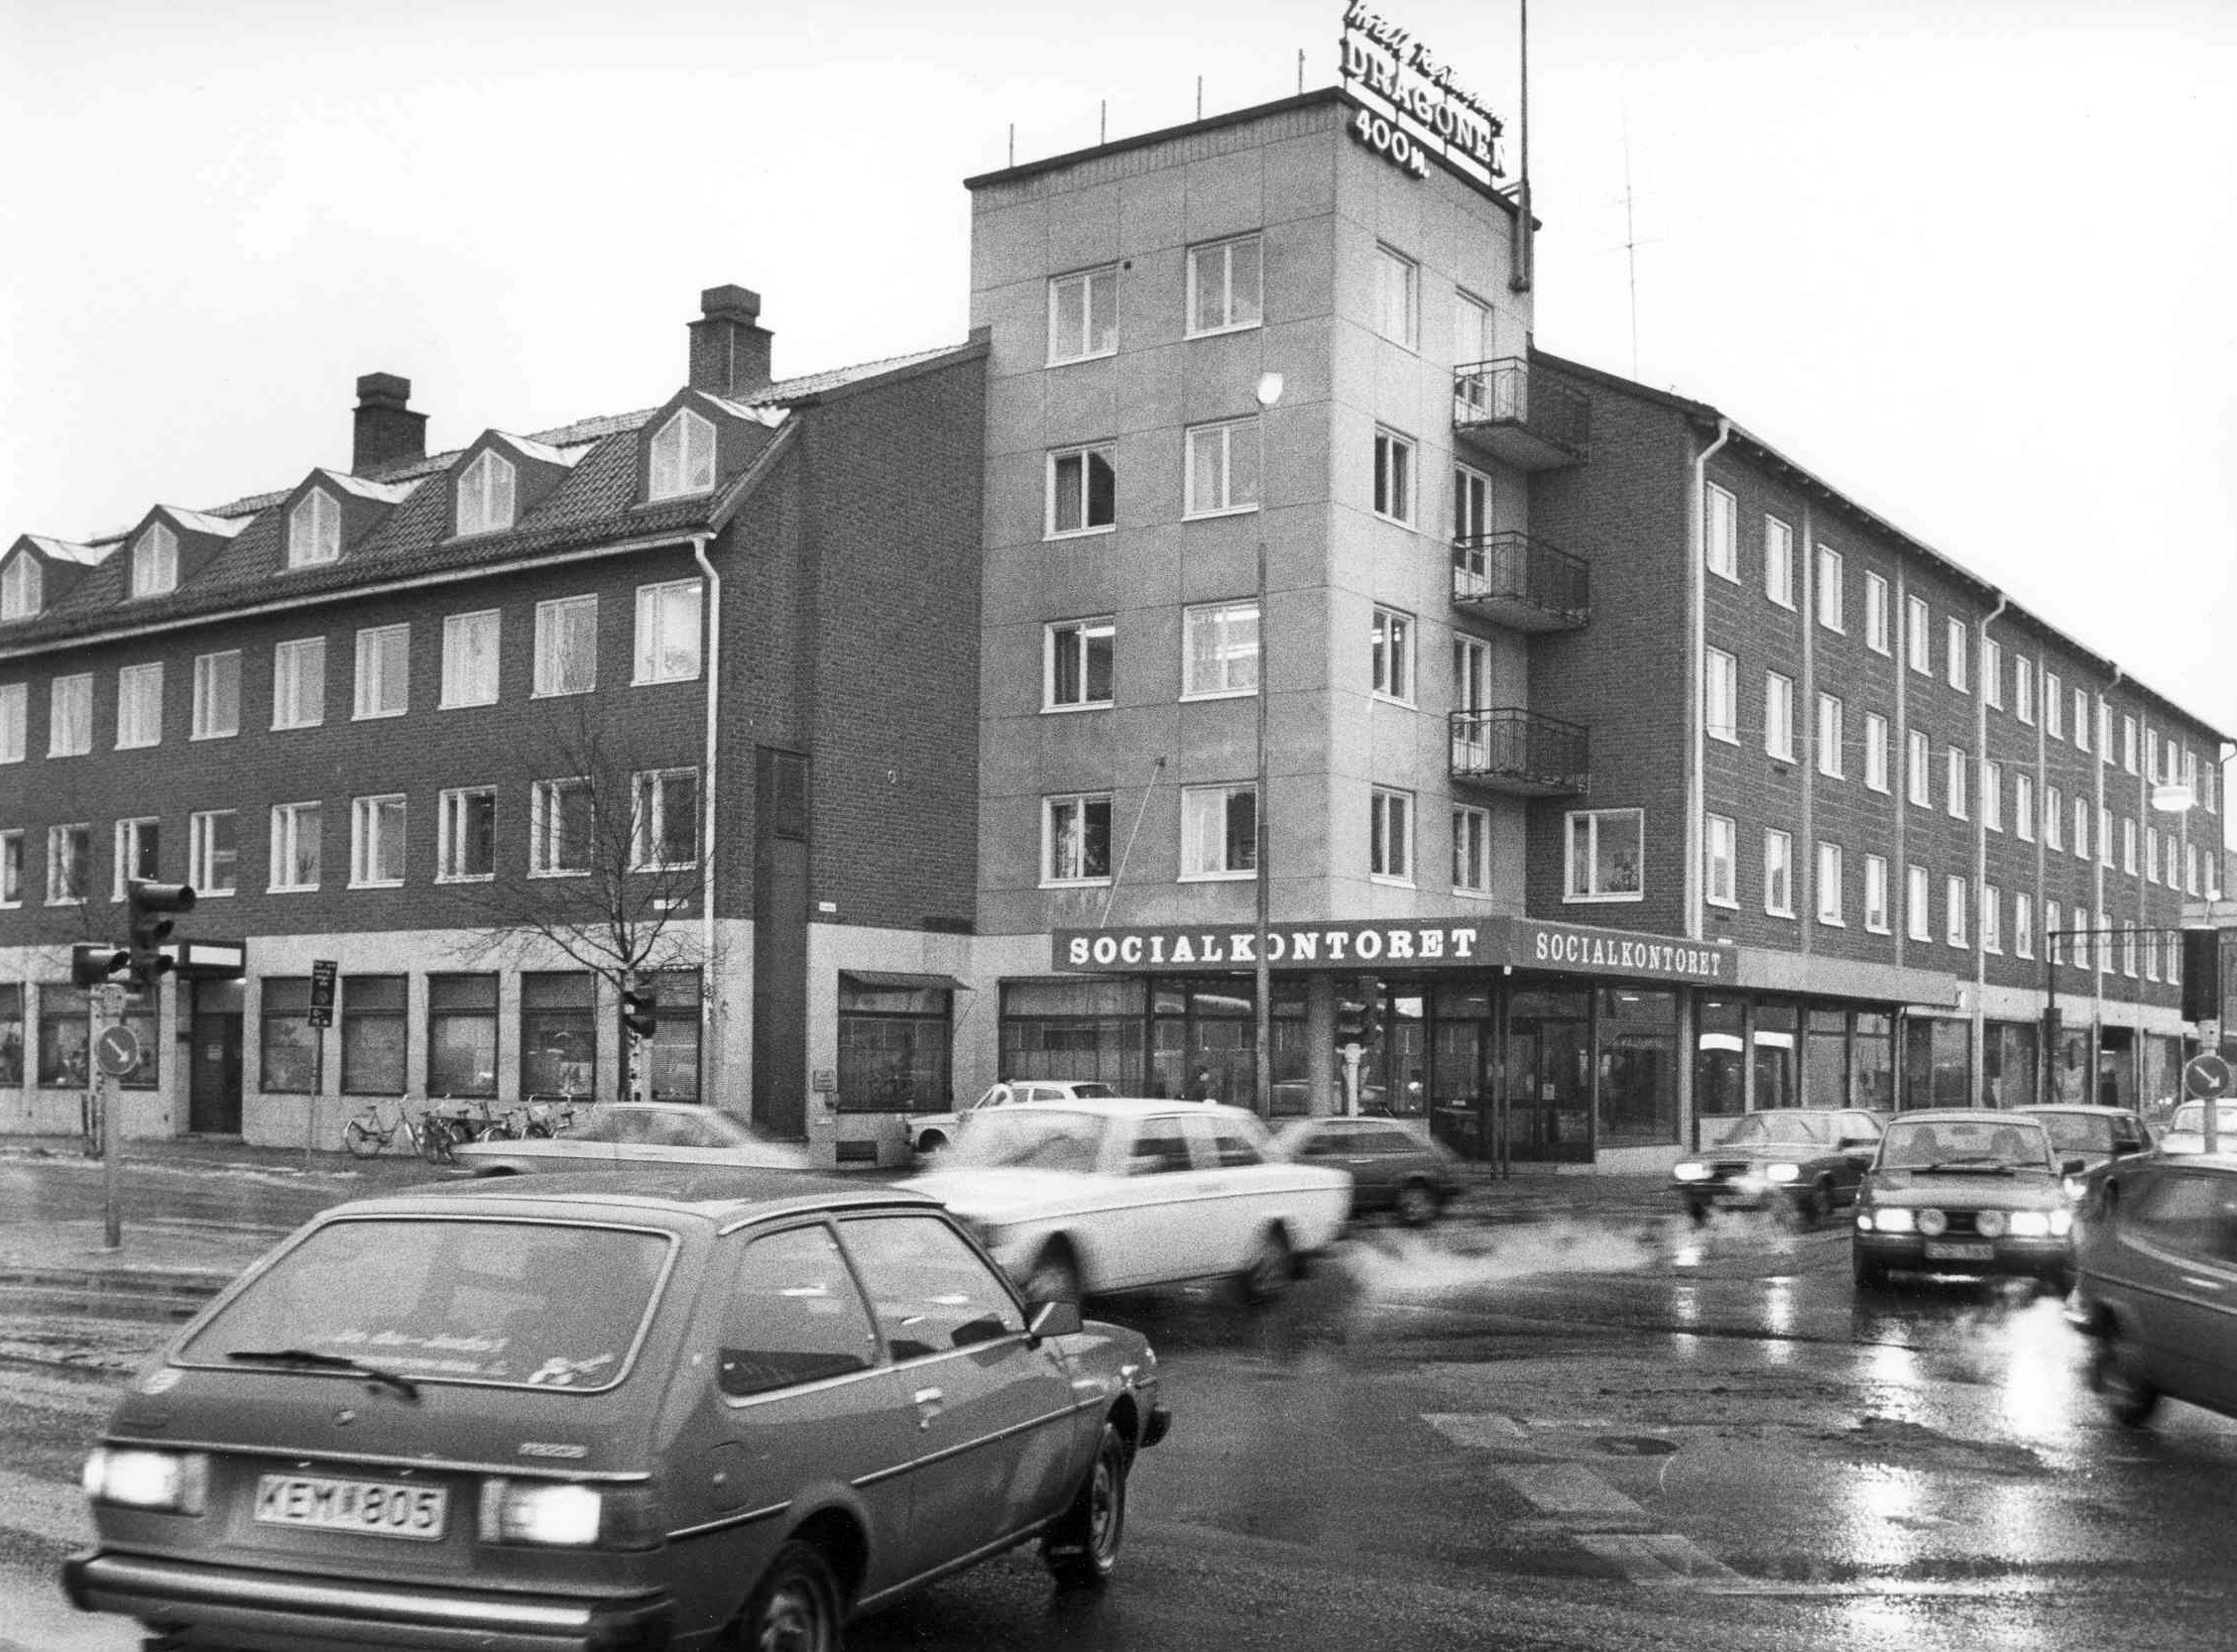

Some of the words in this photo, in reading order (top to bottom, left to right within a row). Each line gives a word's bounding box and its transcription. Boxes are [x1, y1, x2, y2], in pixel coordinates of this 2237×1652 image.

[1346, 36, 1505, 176] DRAGONEN
[1069, 929, 1476, 964] SOCIALKONTORET
[1536, 931, 1720, 976] SOCIALKONTORET
